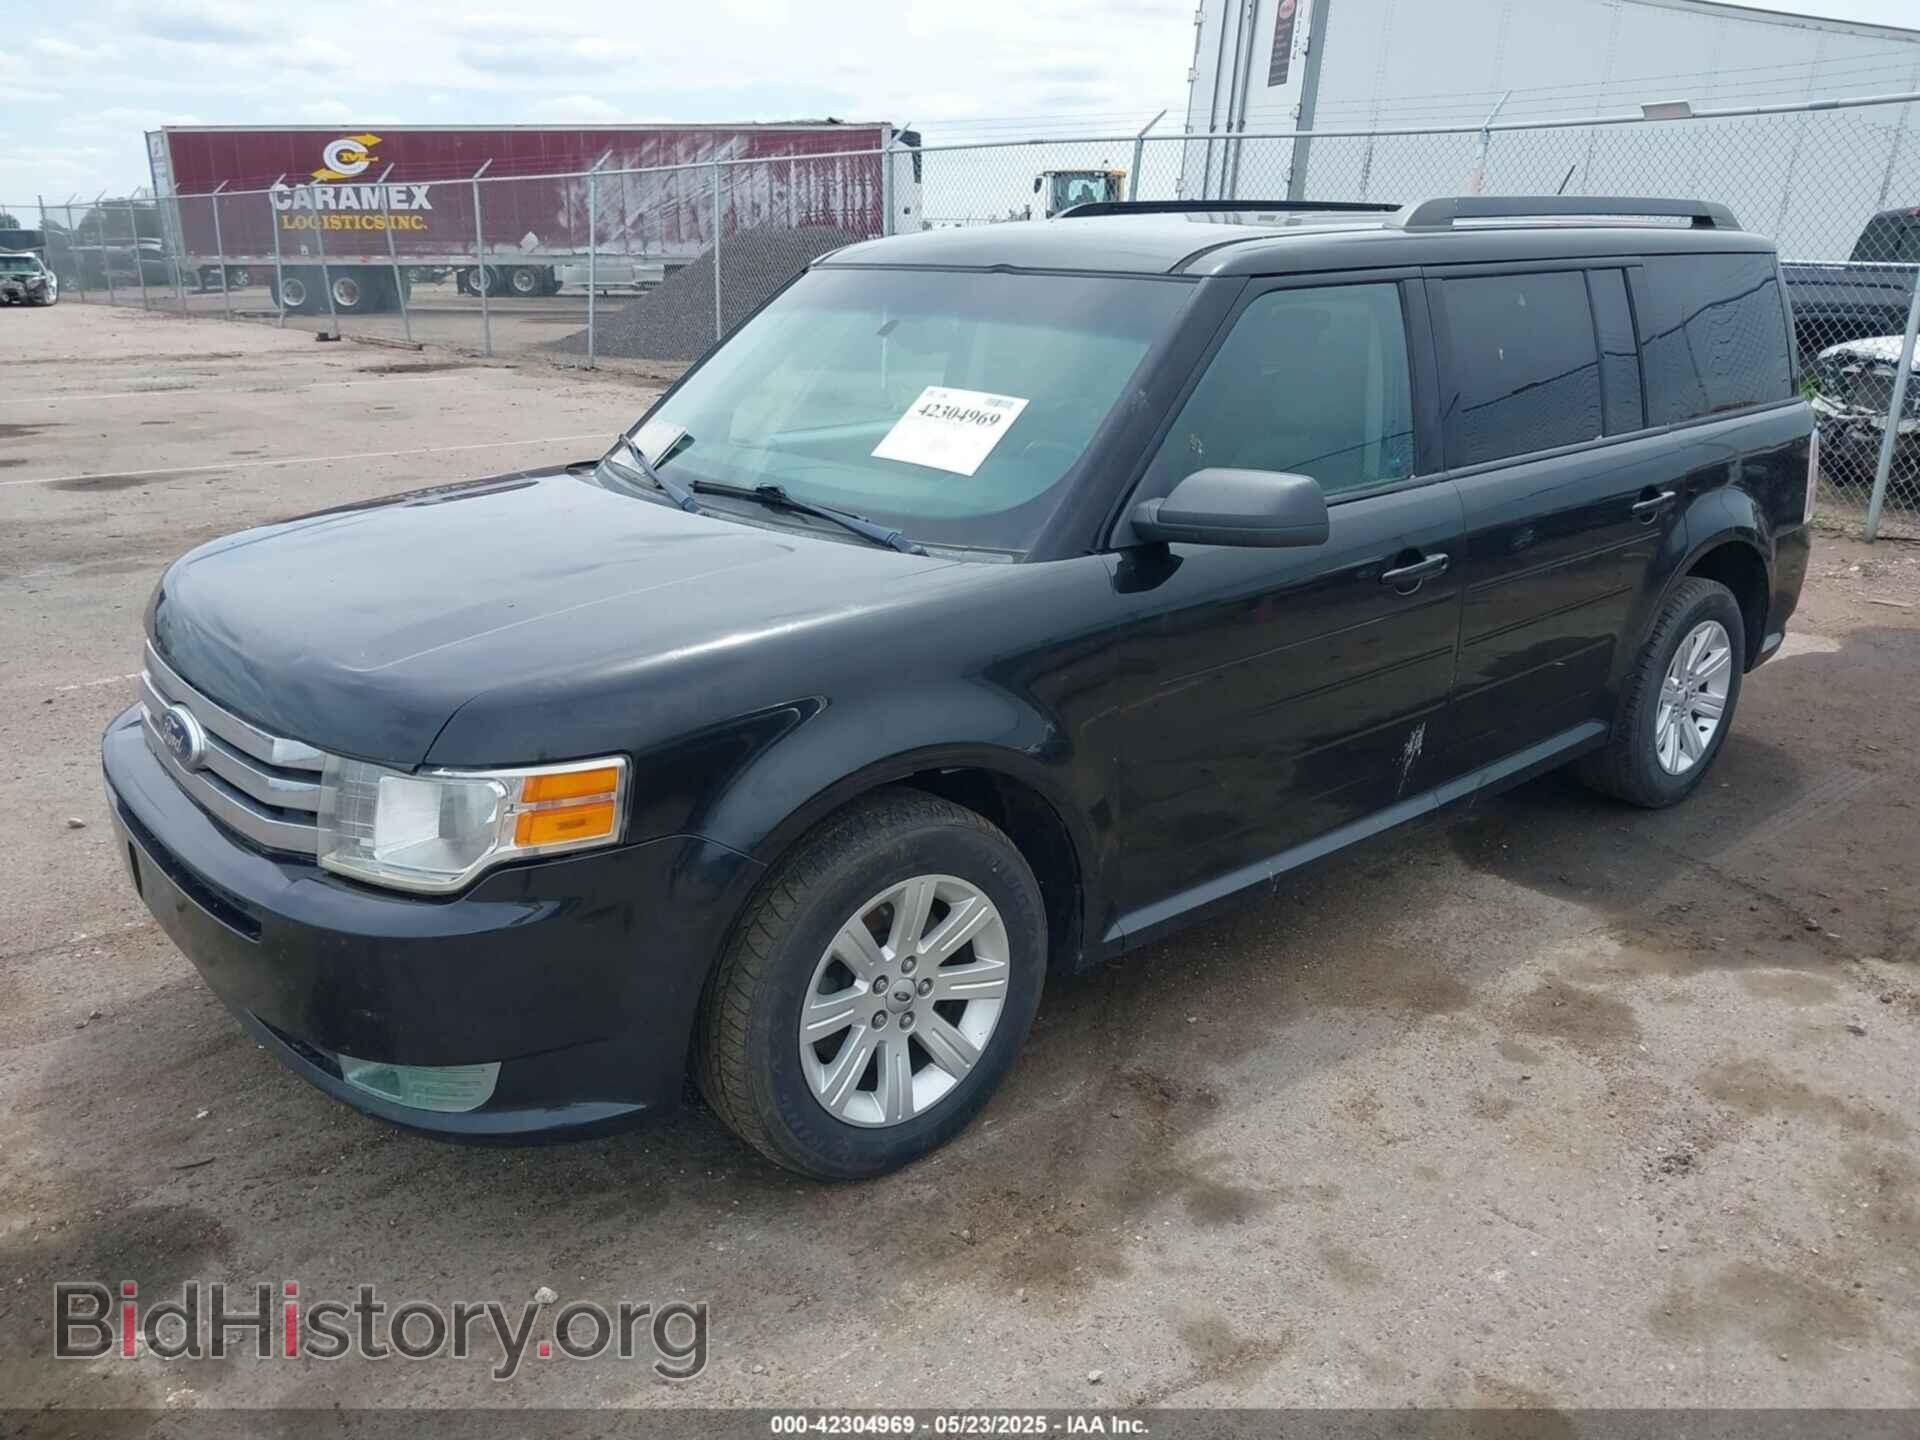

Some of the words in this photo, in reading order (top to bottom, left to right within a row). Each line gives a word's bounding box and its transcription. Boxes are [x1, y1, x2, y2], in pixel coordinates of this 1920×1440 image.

[269, 184, 432, 210] CARAMEX
[388, 215, 428, 230] INC.
[918, 404, 1001, 426] 42304969
